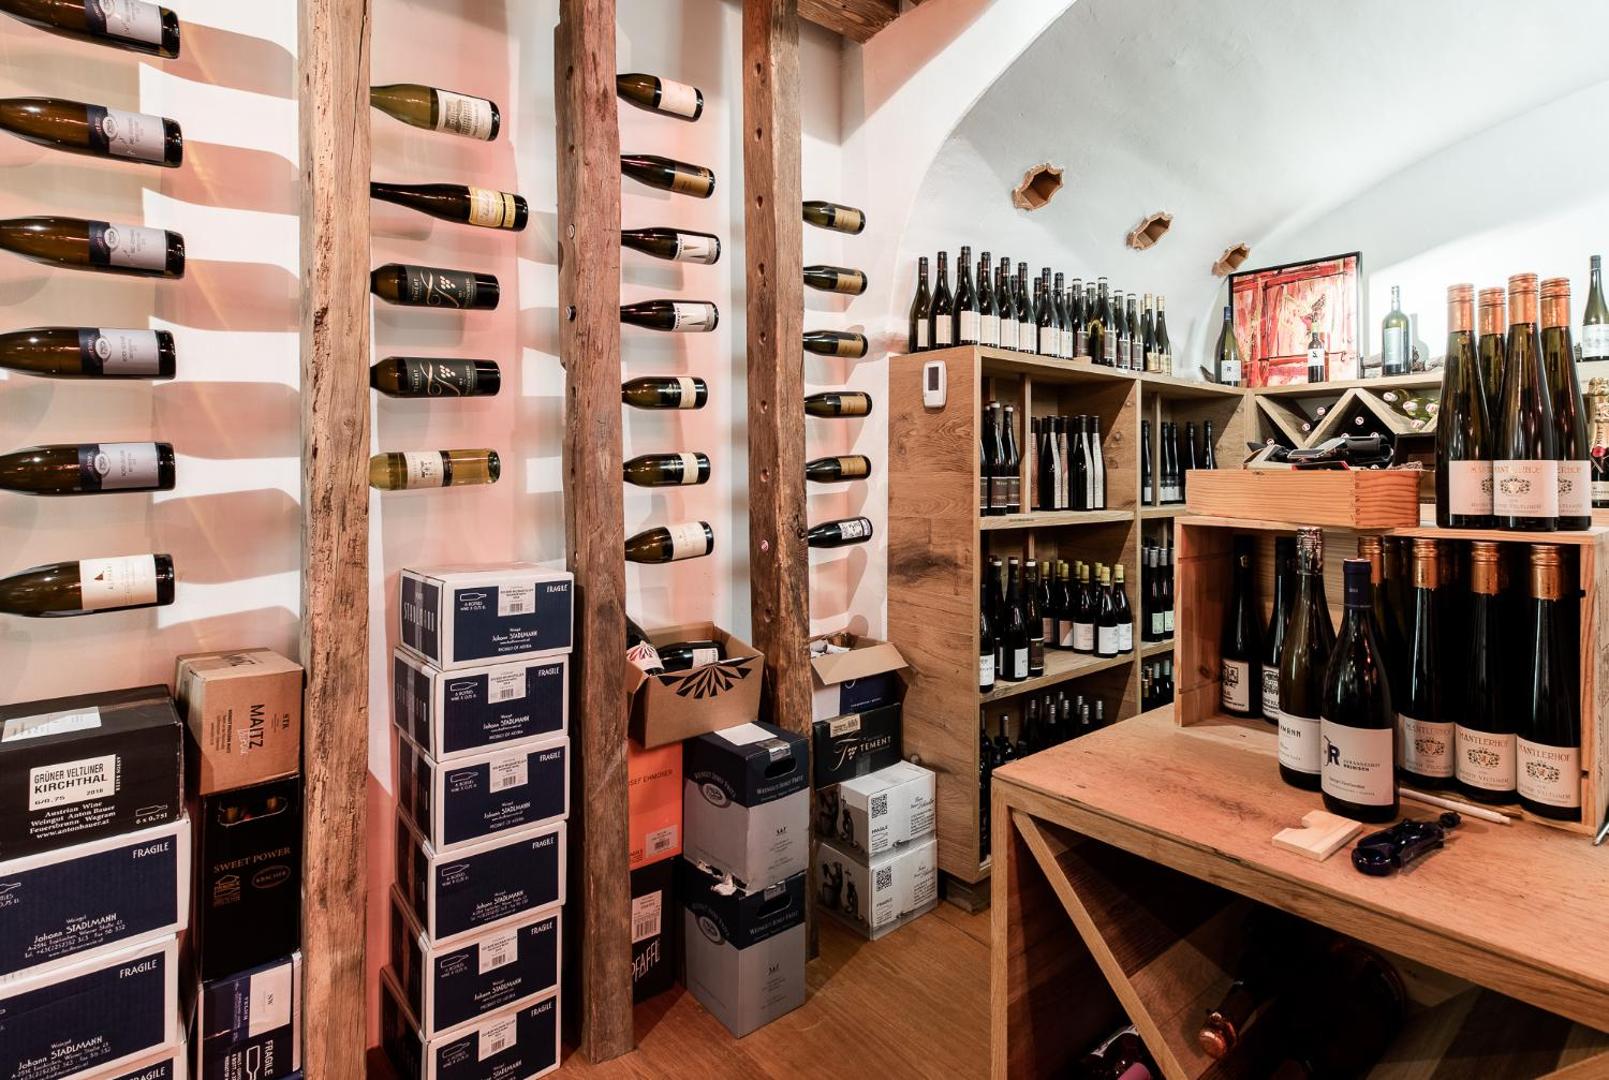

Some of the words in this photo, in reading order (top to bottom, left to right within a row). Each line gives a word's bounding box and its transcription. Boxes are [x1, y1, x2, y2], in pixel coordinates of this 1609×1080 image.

[546, 584, 568, 593] FRAGILE
[492, 634, 508, 642] Johann
[509, 630, 538, 640] STADLMANN
[538, 667, 560, 677] FRAGILE
[249, 704, 265, 749] MAITZ
[500, 715, 530, 727] STADLMANN
[860, 736, 891, 752] TEMENT
[1459, 732, 1510, 747] MANTLERHOF
[540, 751, 561, 762] FRAGILE
[34, 770, 65, 784] GRÜNER
[67, 763, 104, 778] VELTLINER
[34, 773, 108, 794] KIRCHTHAL
[31, 815, 64, 827] Weingut
[68, 811, 92, 820] Anton
[94, 805, 115, 814] Bauer
[45, 806, 79, 818] Austrian
[82, 801, 103, 811] Wine
[501, 801, 531, 815] STADLMANN
[29, 820, 79, 834] Feuersbrunn
[85, 811, 116, 823] Wagram
[133, 841, 169, 858] FRAGILE
[532, 837, 554, 849] FRAGILE
[213, 857, 251, 873] SWEET
[253, 847, 291, 863] POWER
[34, 931, 63, 944] Johann
[66, 912, 117, 934] STADLMANN
[531, 922, 553, 935] FRAGILE
[119, 959, 157, 979] FRAGILE
[531, 1001, 553, 1017] FRAGILE
[18, 1055, 47, 1071] Johann
[51, 1035, 103, 1060] STADLMANN
[264, 1040, 274, 1077] FRAGILE
